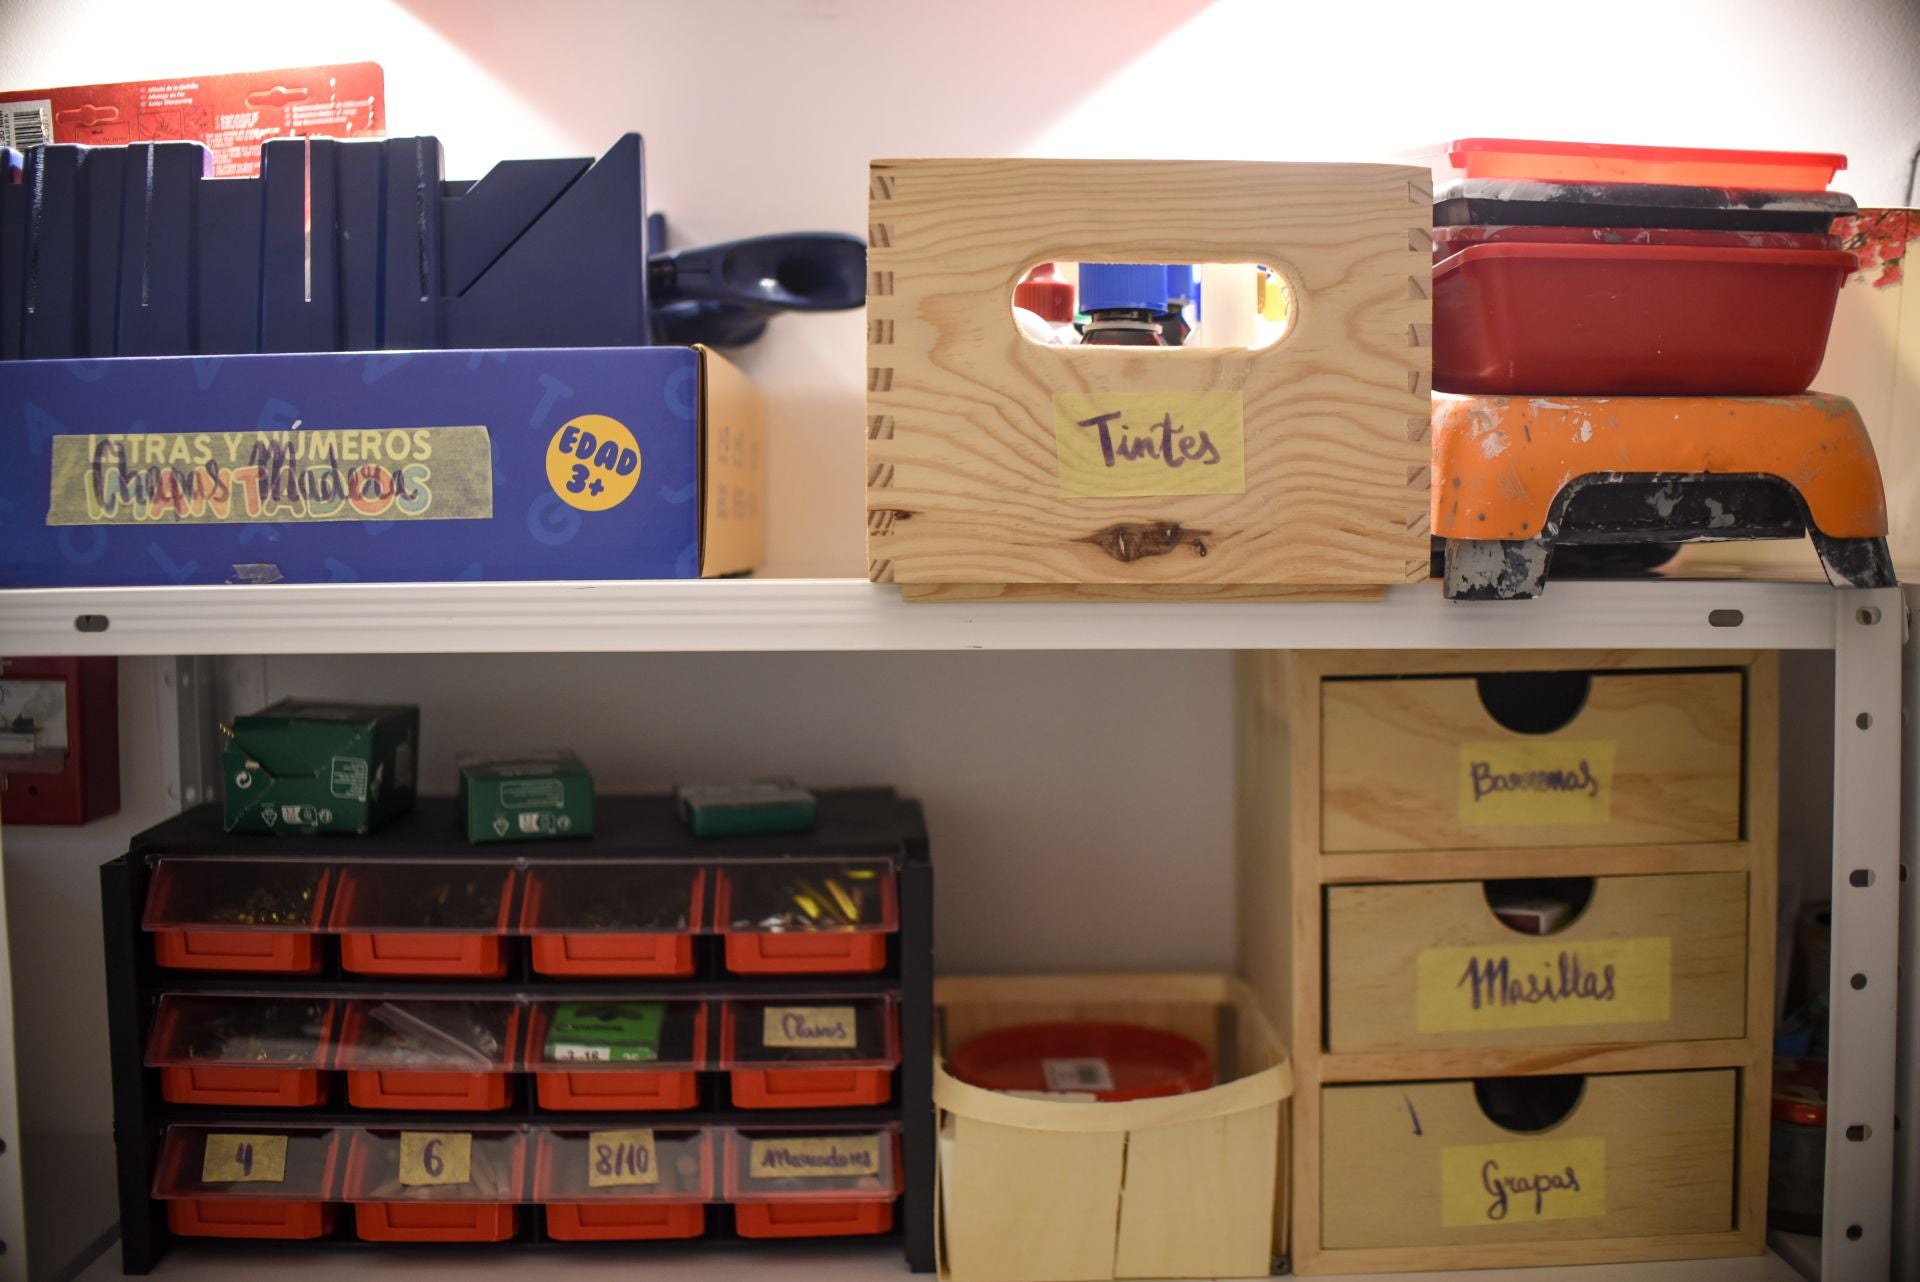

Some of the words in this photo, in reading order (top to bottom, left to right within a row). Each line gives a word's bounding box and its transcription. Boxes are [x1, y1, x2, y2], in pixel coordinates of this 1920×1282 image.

[88, 434, 214, 464] LETRAS
[223, 433, 243, 463] Y
[558, 425, 638, 476] EDAD
[1077, 410, 1221, 468] Tintes
[565, 464, 605, 497] 3+
[1456, 951, 1616, 1010] Masillas
[235, 1142, 253, 1176] 4
[423, 1138, 444, 1177] 6
[595, 1143, 649, 1176] 8/10
[1482, 1160, 1580, 1220] Grapas
